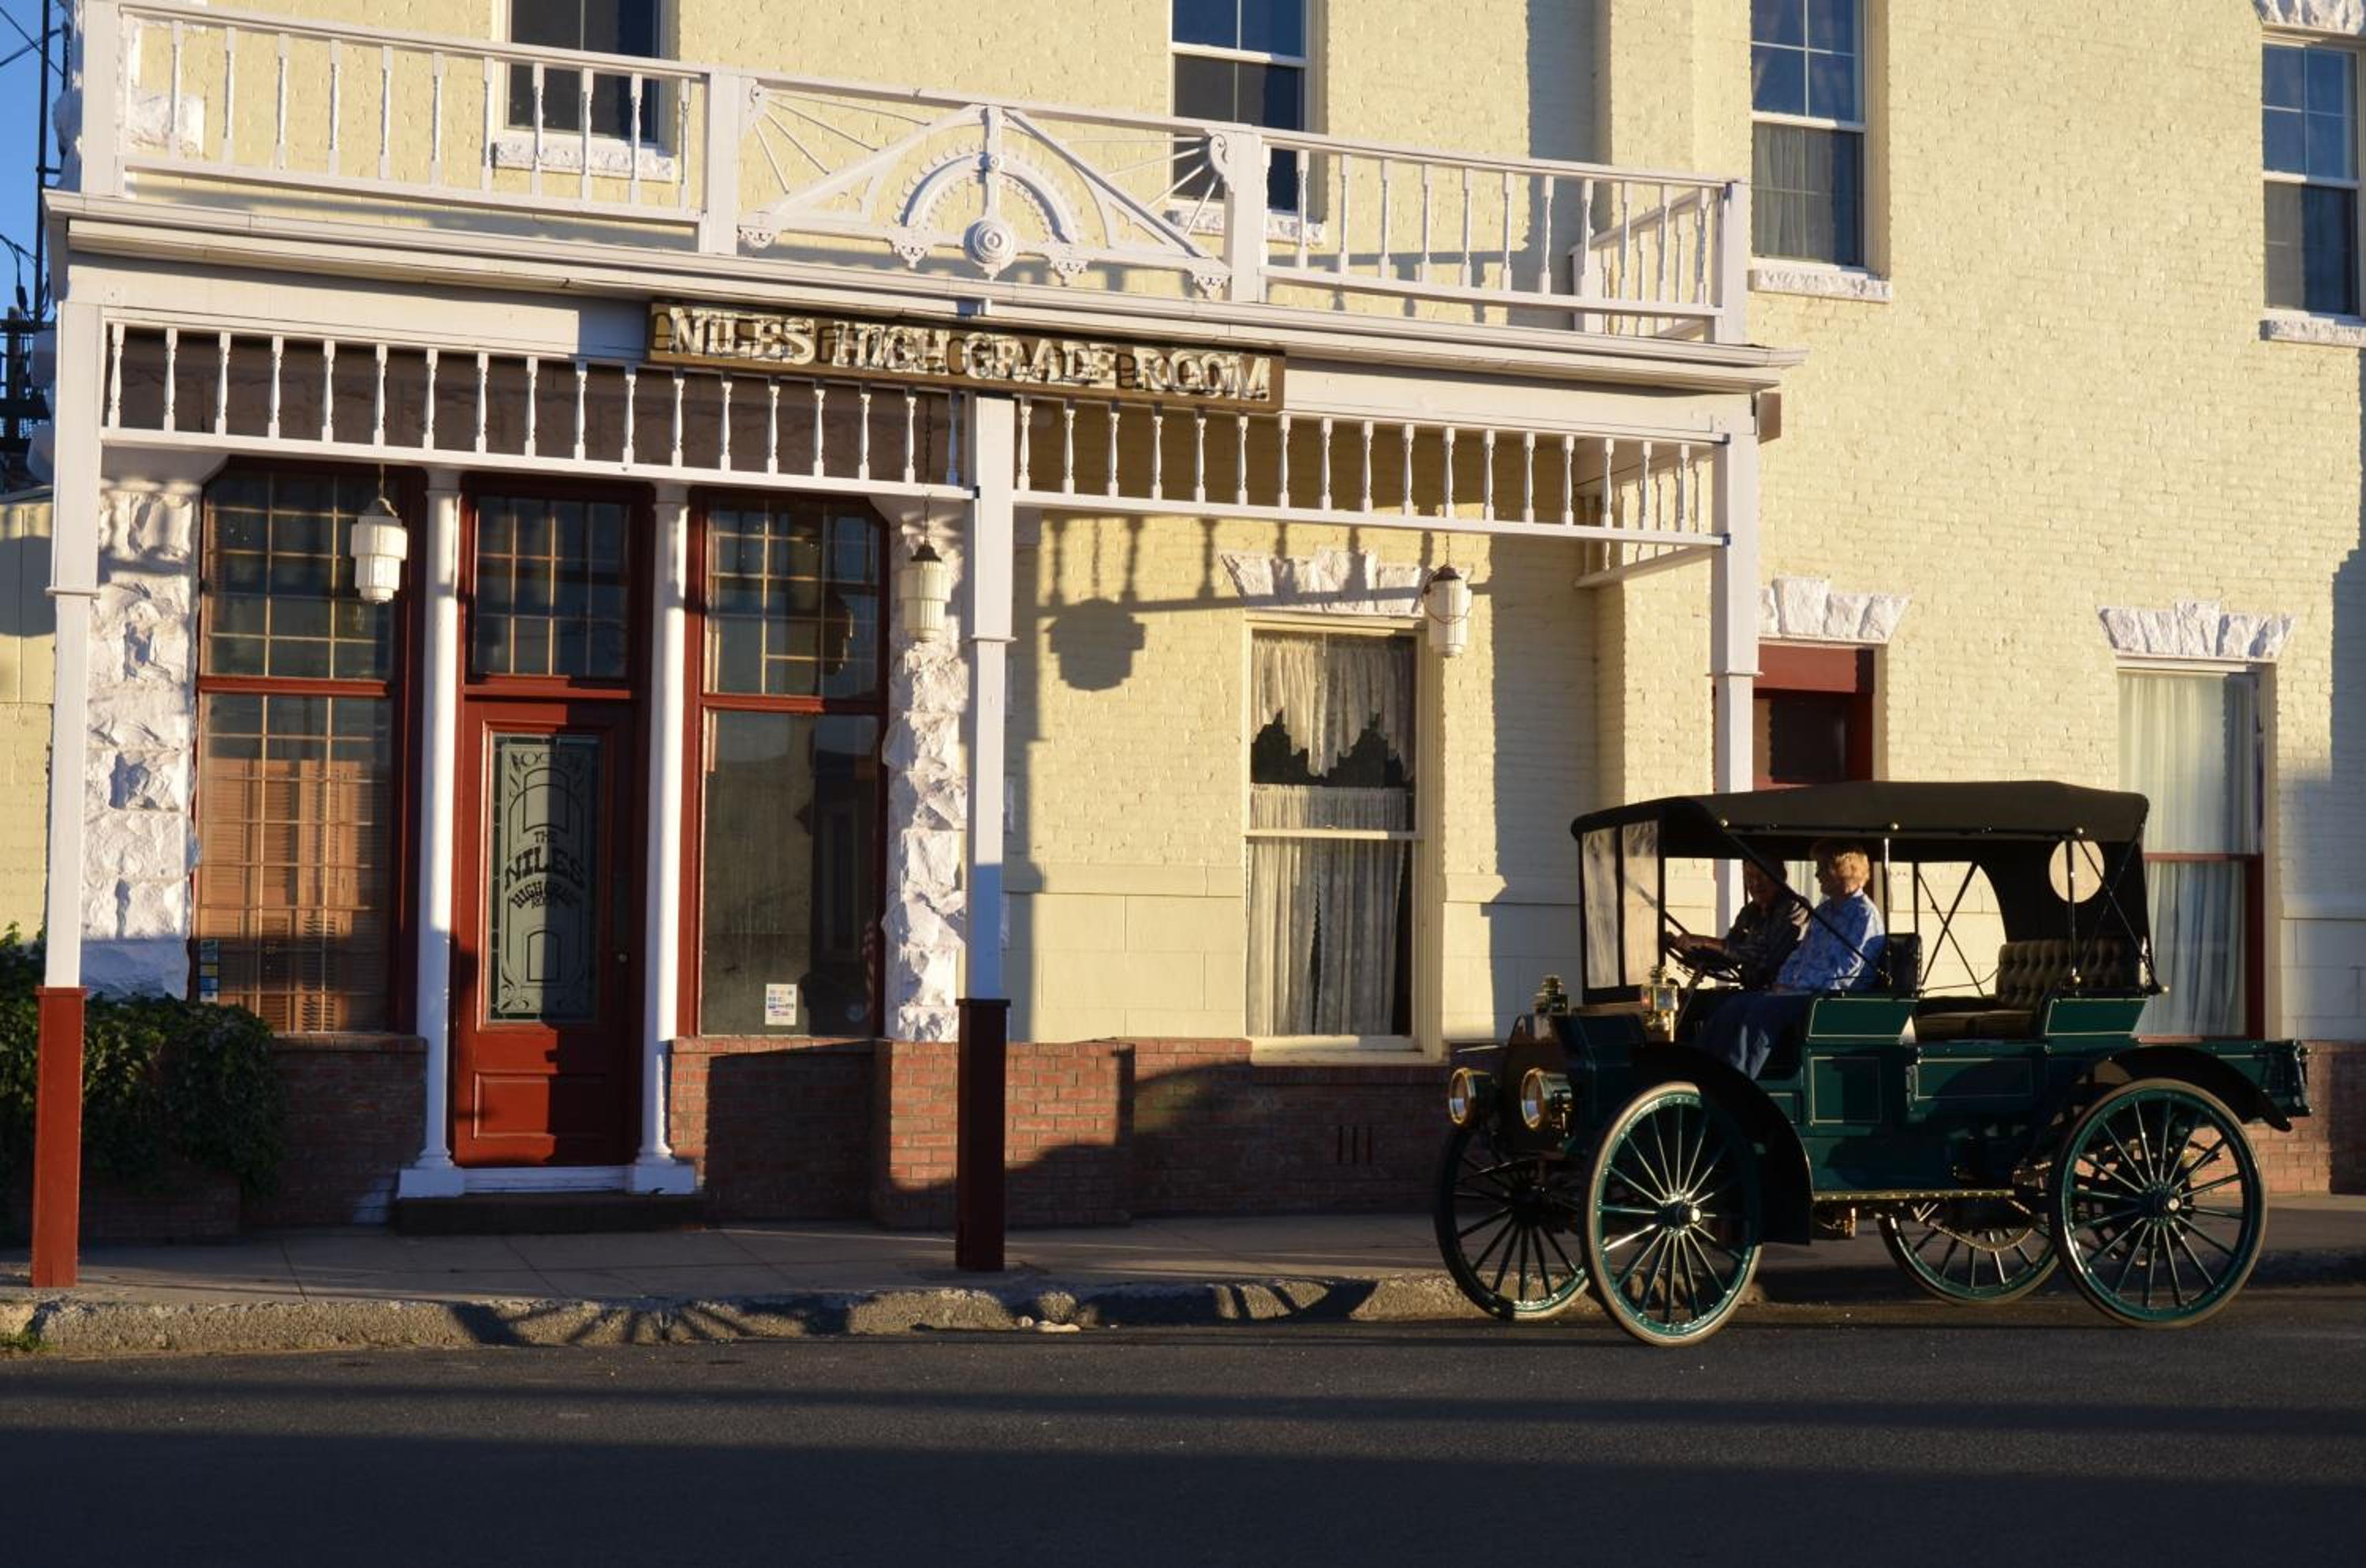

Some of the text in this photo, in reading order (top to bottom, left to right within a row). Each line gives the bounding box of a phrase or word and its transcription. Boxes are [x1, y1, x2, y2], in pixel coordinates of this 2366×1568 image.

[669, 306, 1271, 402] NILES HIGH GRADE ROOM
[534, 831, 556, 843] THE
[505, 845, 587, 892] NILES
[511, 879, 543, 909] HIGH
